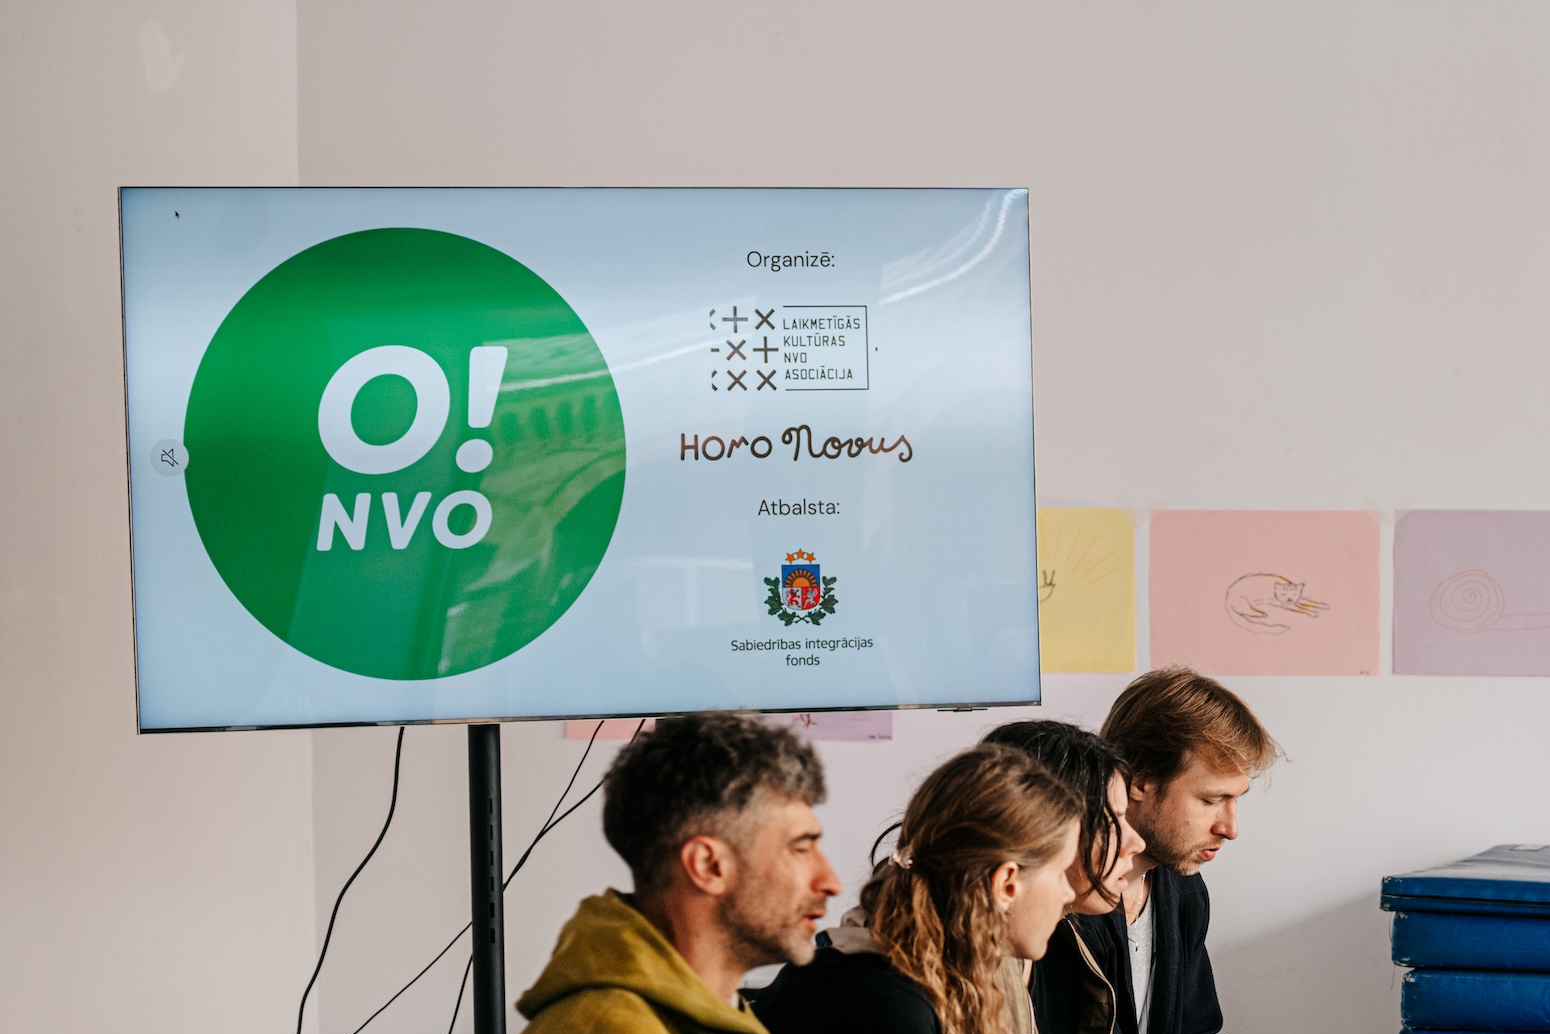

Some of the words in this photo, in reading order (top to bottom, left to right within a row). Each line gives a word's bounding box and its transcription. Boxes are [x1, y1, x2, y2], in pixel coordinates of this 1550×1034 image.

[746, 250, 835, 272] Organizē:
[782, 315, 861, 331] LAIKMETĪGĀS
[783, 332, 847, 347] KULTŪRAS
[784, 352, 808, 364] NVO
[785, 365, 853, 381] ASOCIĀCIJA
[317, 344, 508, 475] O!
[758, 498, 841, 516] Atbalsta:
[316, 489, 494, 552] NVO
[730, 637, 802, 652] Sabiedrības
[804, 636, 874, 652] integrācijas
[785, 654, 821, 667] fonds
